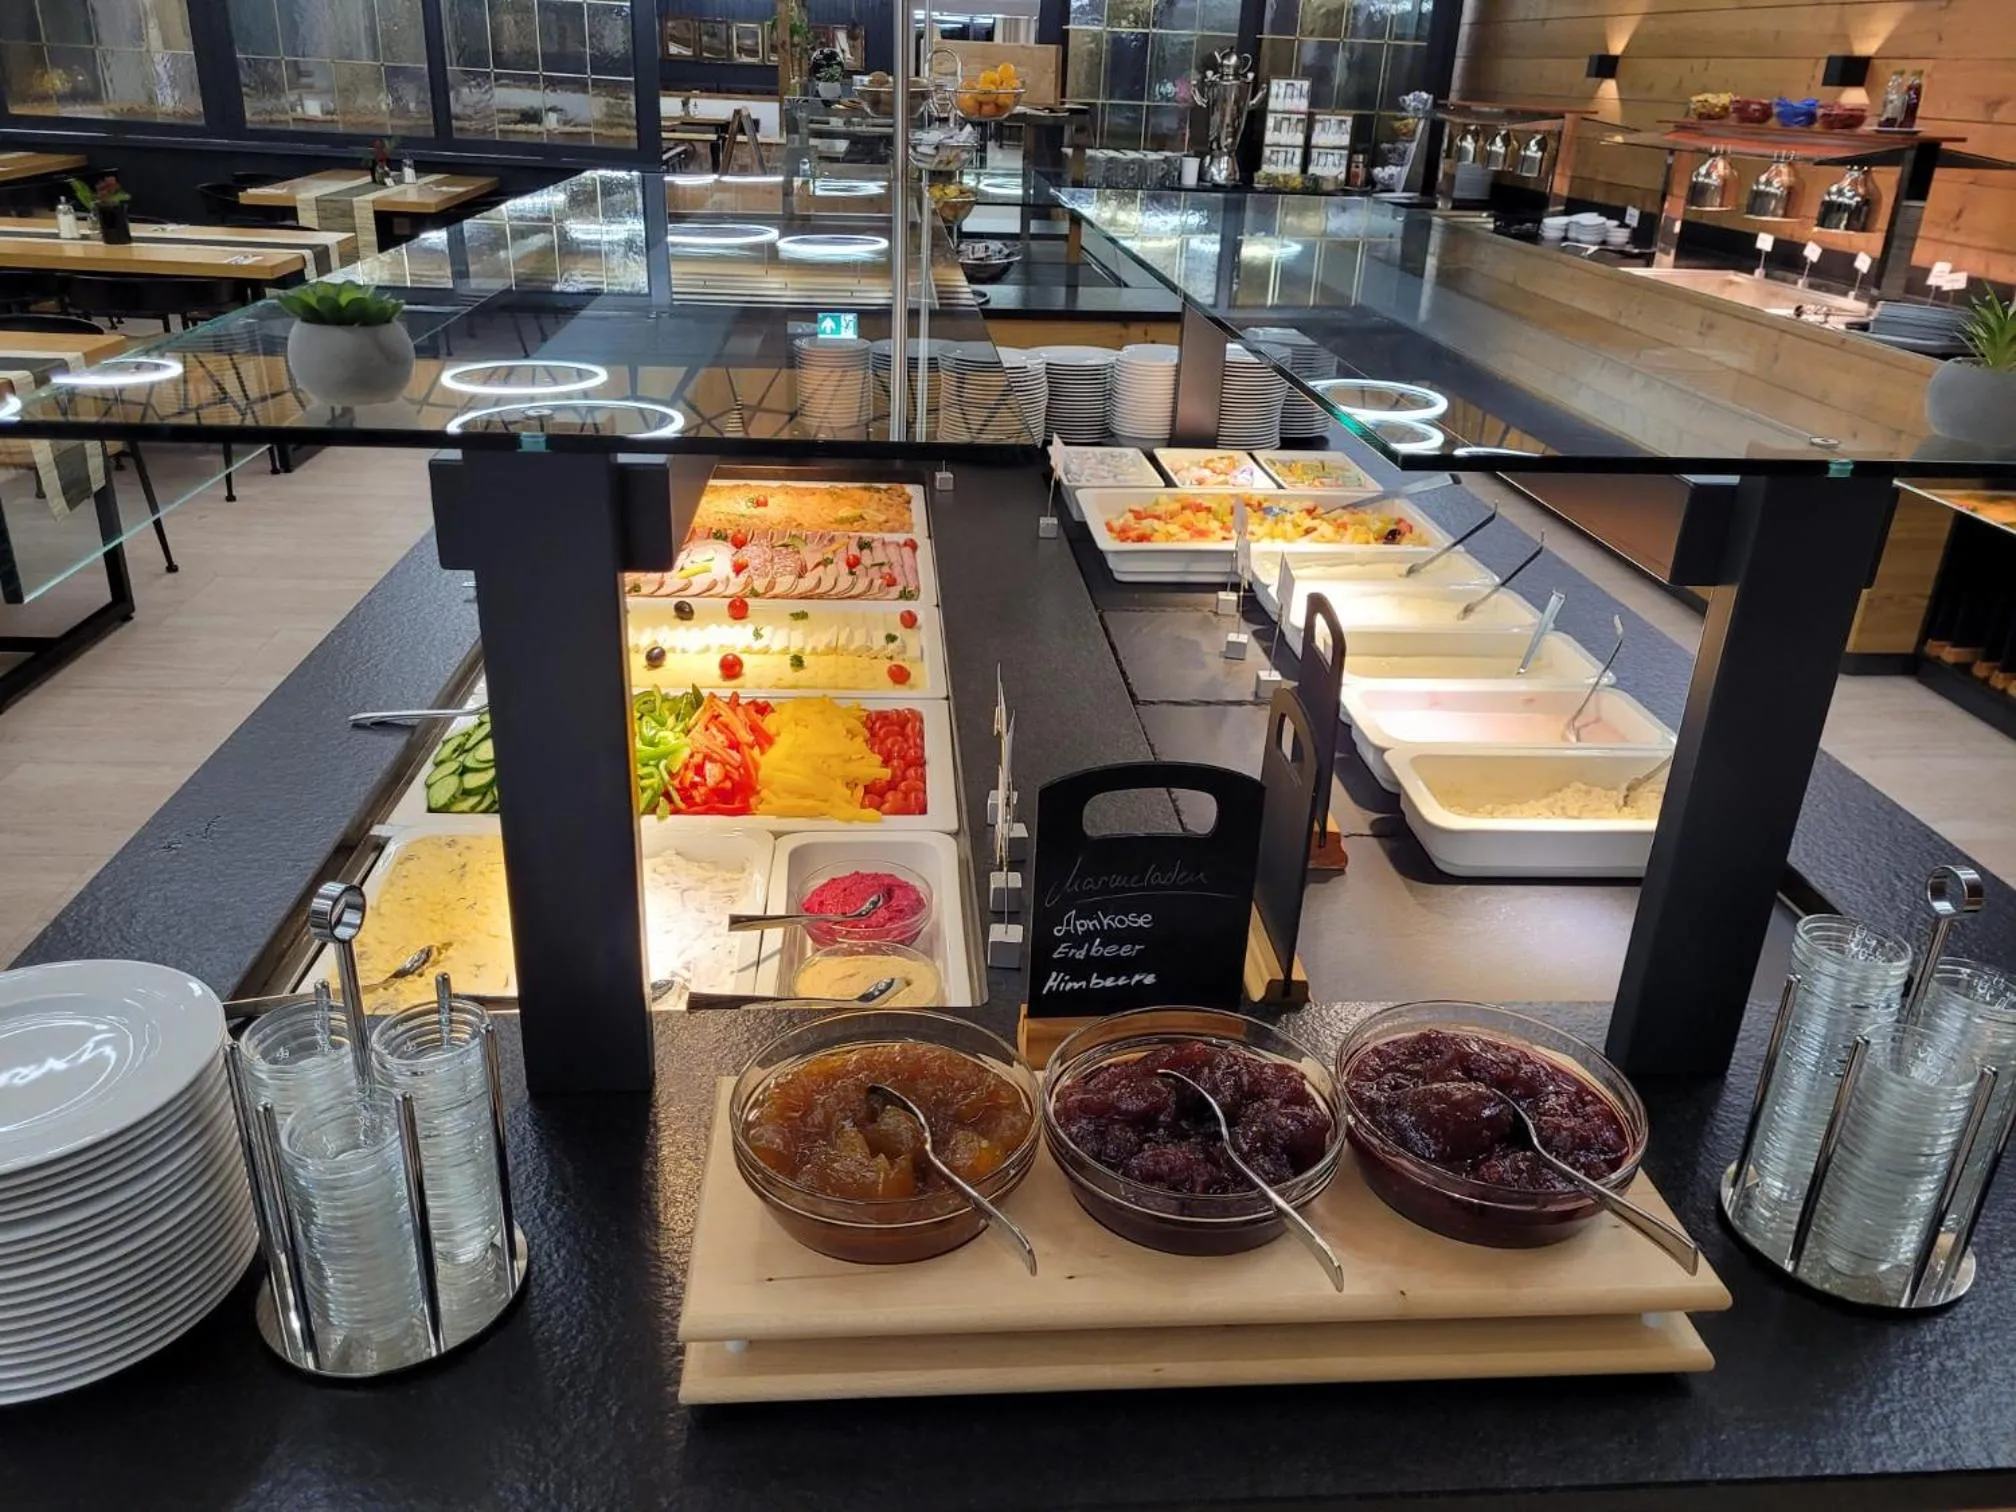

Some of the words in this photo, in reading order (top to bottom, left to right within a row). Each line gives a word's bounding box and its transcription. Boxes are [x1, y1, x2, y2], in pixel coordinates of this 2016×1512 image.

[1053, 909, 1154, 936] Aprikose
[1052, 938, 1145, 960] Erdbeer
[1042, 971, 1157, 994] Himbeere
